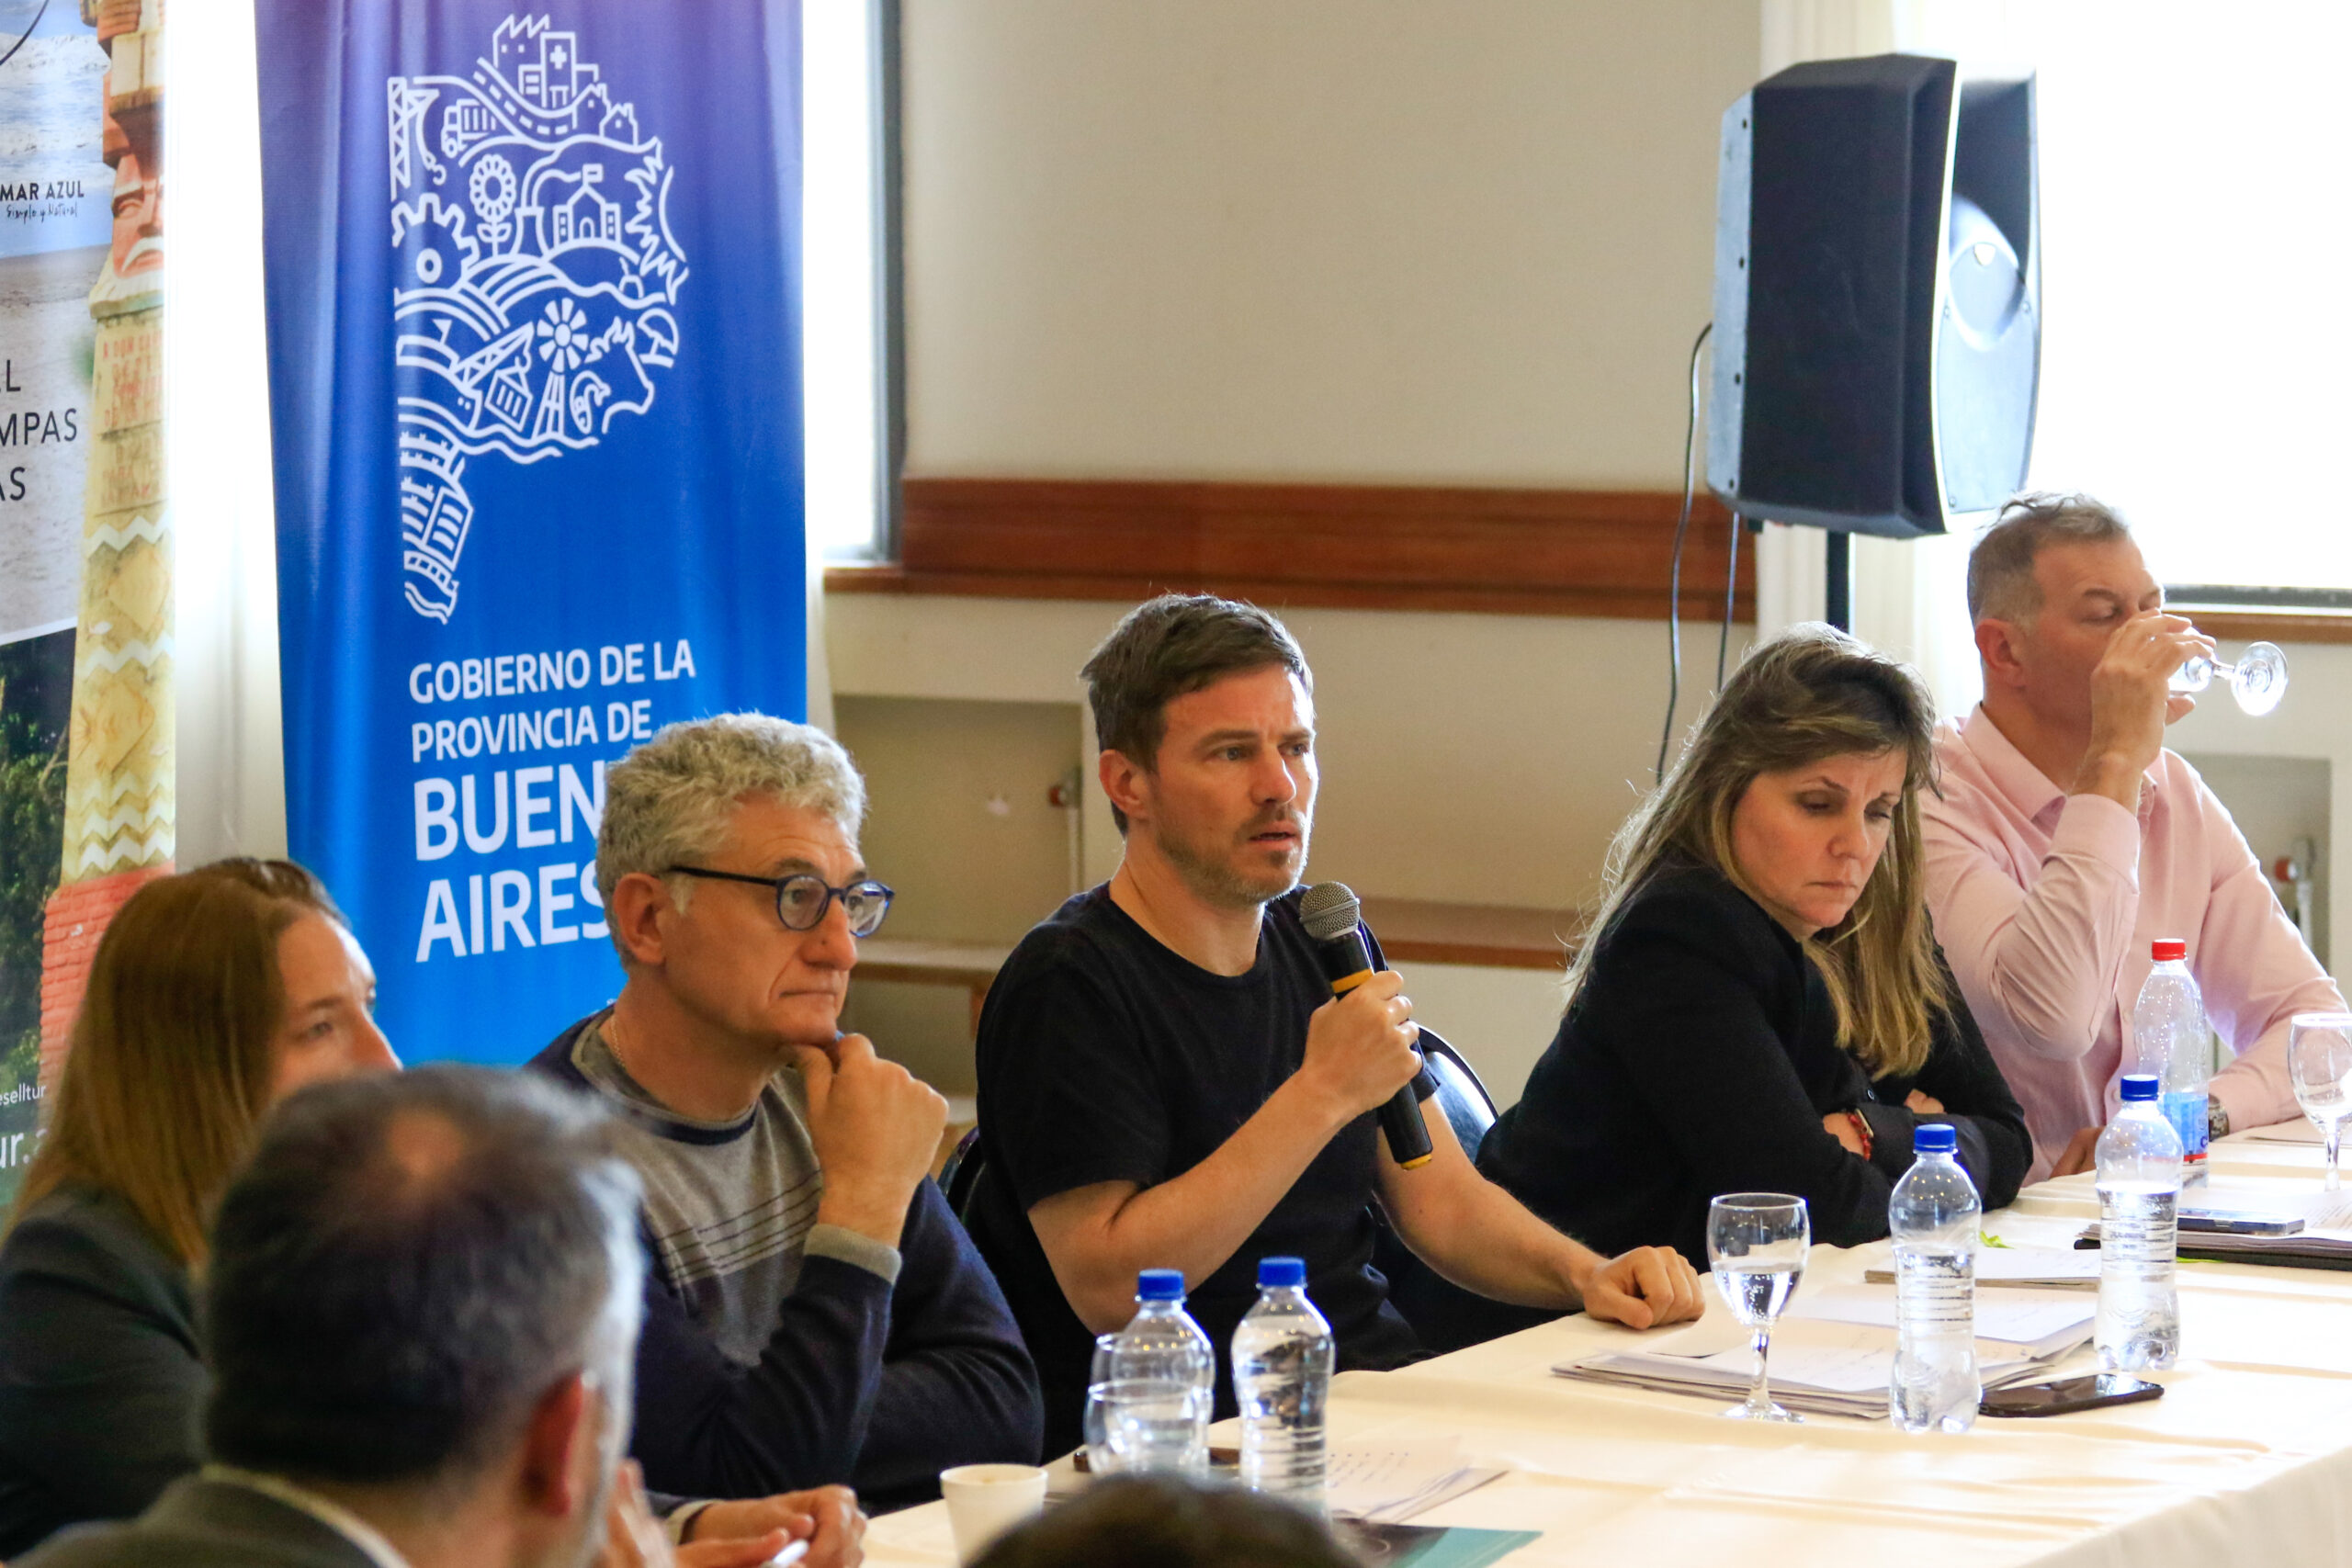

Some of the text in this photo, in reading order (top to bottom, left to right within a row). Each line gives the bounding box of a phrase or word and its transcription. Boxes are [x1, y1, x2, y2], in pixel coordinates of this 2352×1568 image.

[0, 180, 85, 201] MAR AZUL
[409, 639, 695, 704] GOBIERNO DE LA
[412, 699, 651, 762] PROVINCIA DE
[415, 859, 610, 963] AIRES
[0, 1082, 47, 1106] selltur
